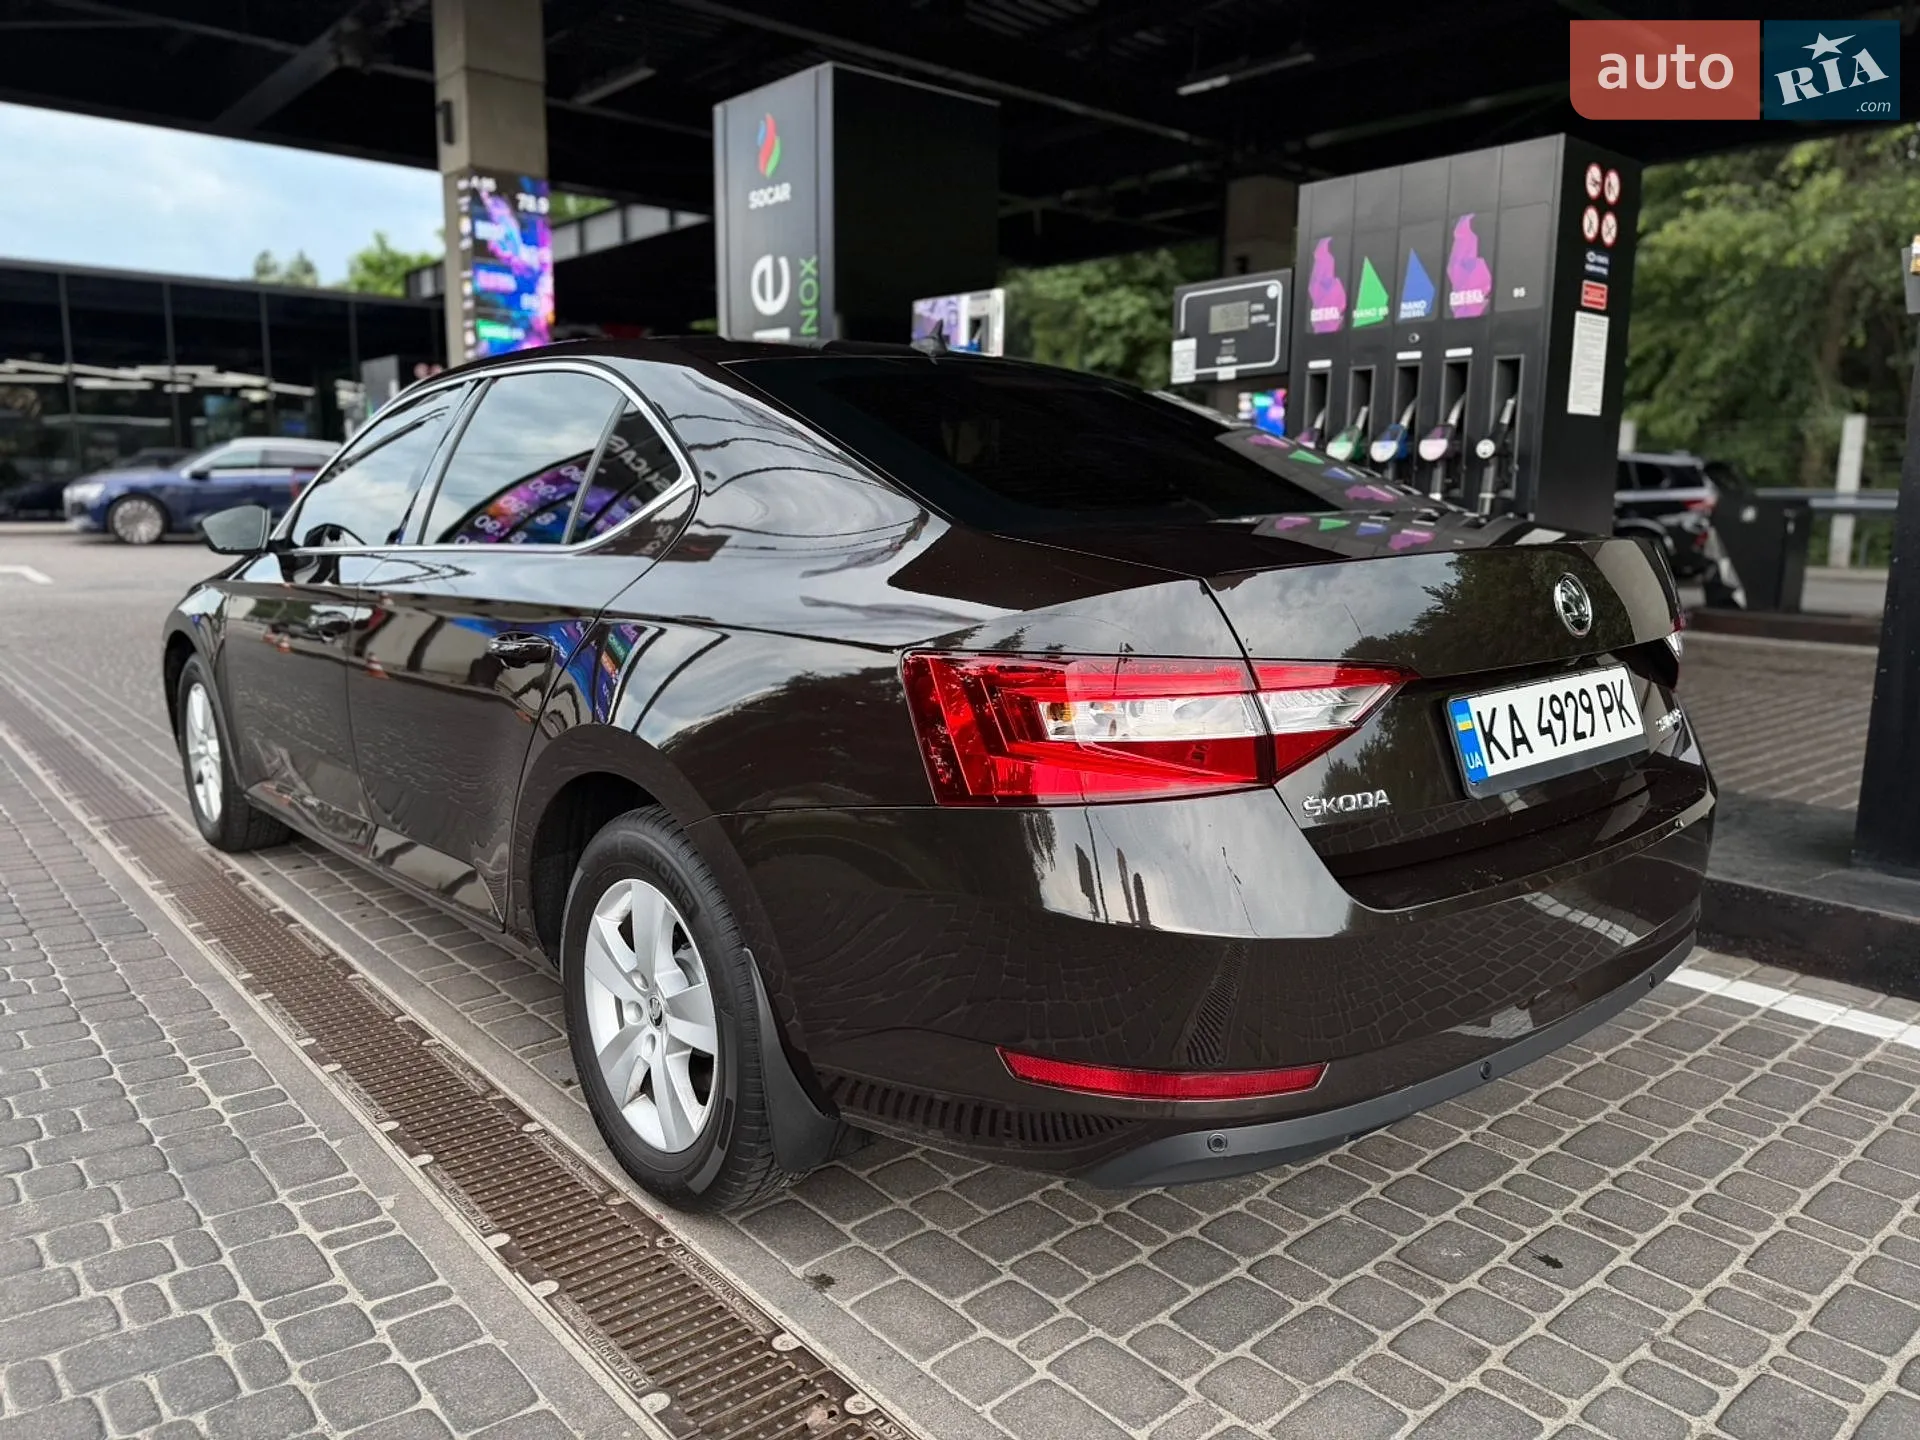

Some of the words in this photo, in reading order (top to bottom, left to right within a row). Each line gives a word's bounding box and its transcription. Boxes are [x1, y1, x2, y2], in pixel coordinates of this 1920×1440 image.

[749, 182, 791, 209] SOCAR
[800, 256, 818, 338] NOX
[1400, 299, 1427, 310] NANO
[1466, 752, 1483, 770] UA
[1477, 703, 1534, 764] KA
[1537, 688, 1595, 747] 4929
[1596, 679, 1636, 733] PK
[1302, 789, 1392, 817] ŠKODA
